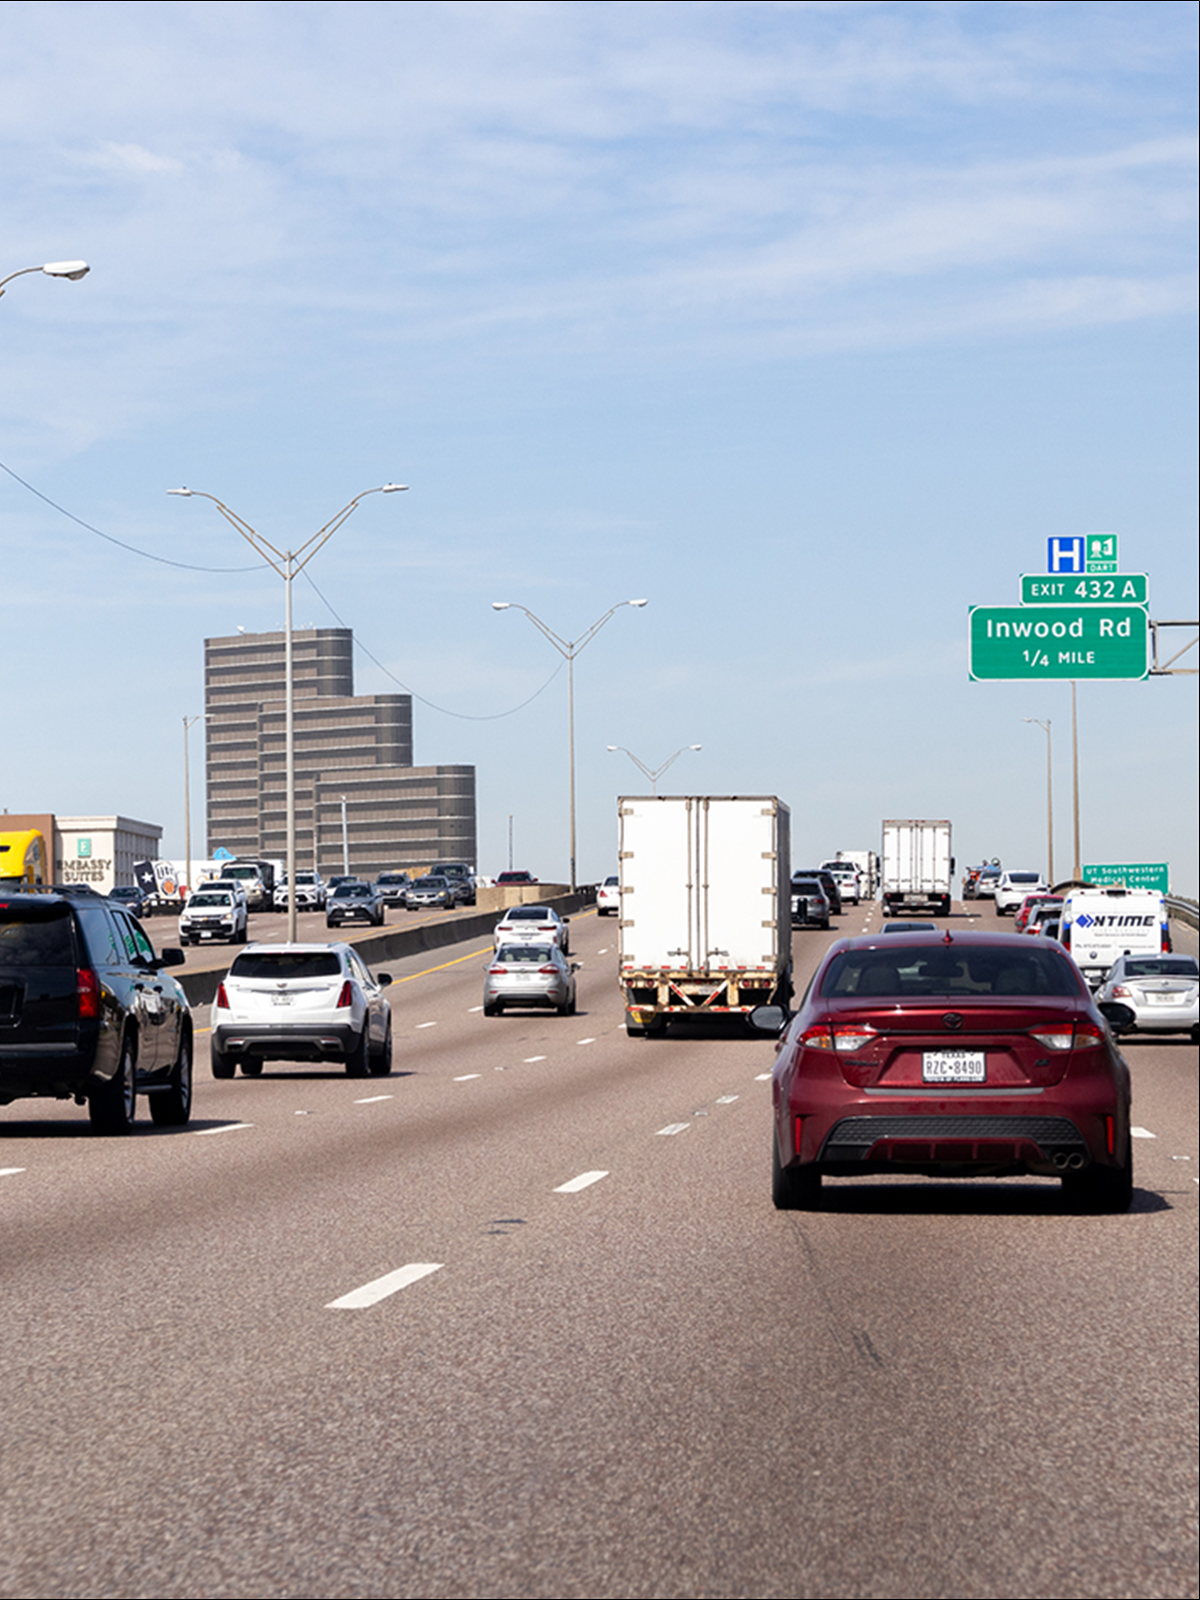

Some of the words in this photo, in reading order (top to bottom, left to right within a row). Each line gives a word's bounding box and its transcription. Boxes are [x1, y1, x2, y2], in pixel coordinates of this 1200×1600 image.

[1053, 539, 1080, 571] H
[1031, 584, 1065, 596] EXIT
[1074, 580, 1115, 598] 432
[1122, 580, 1136, 598] A
[987, 618, 1083, 638] Inwood
[1099, 617, 1131, 637] Rd
[1023, 650, 1049, 667] 1/4
[1058, 652, 1095, 664] MILE
[57, 859, 111, 870] EMBASSY
[1102, 866, 1164, 875] Southwestern
[64, 871, 104, 882] SUITES
[1129, 875, 1159, 883] Center
